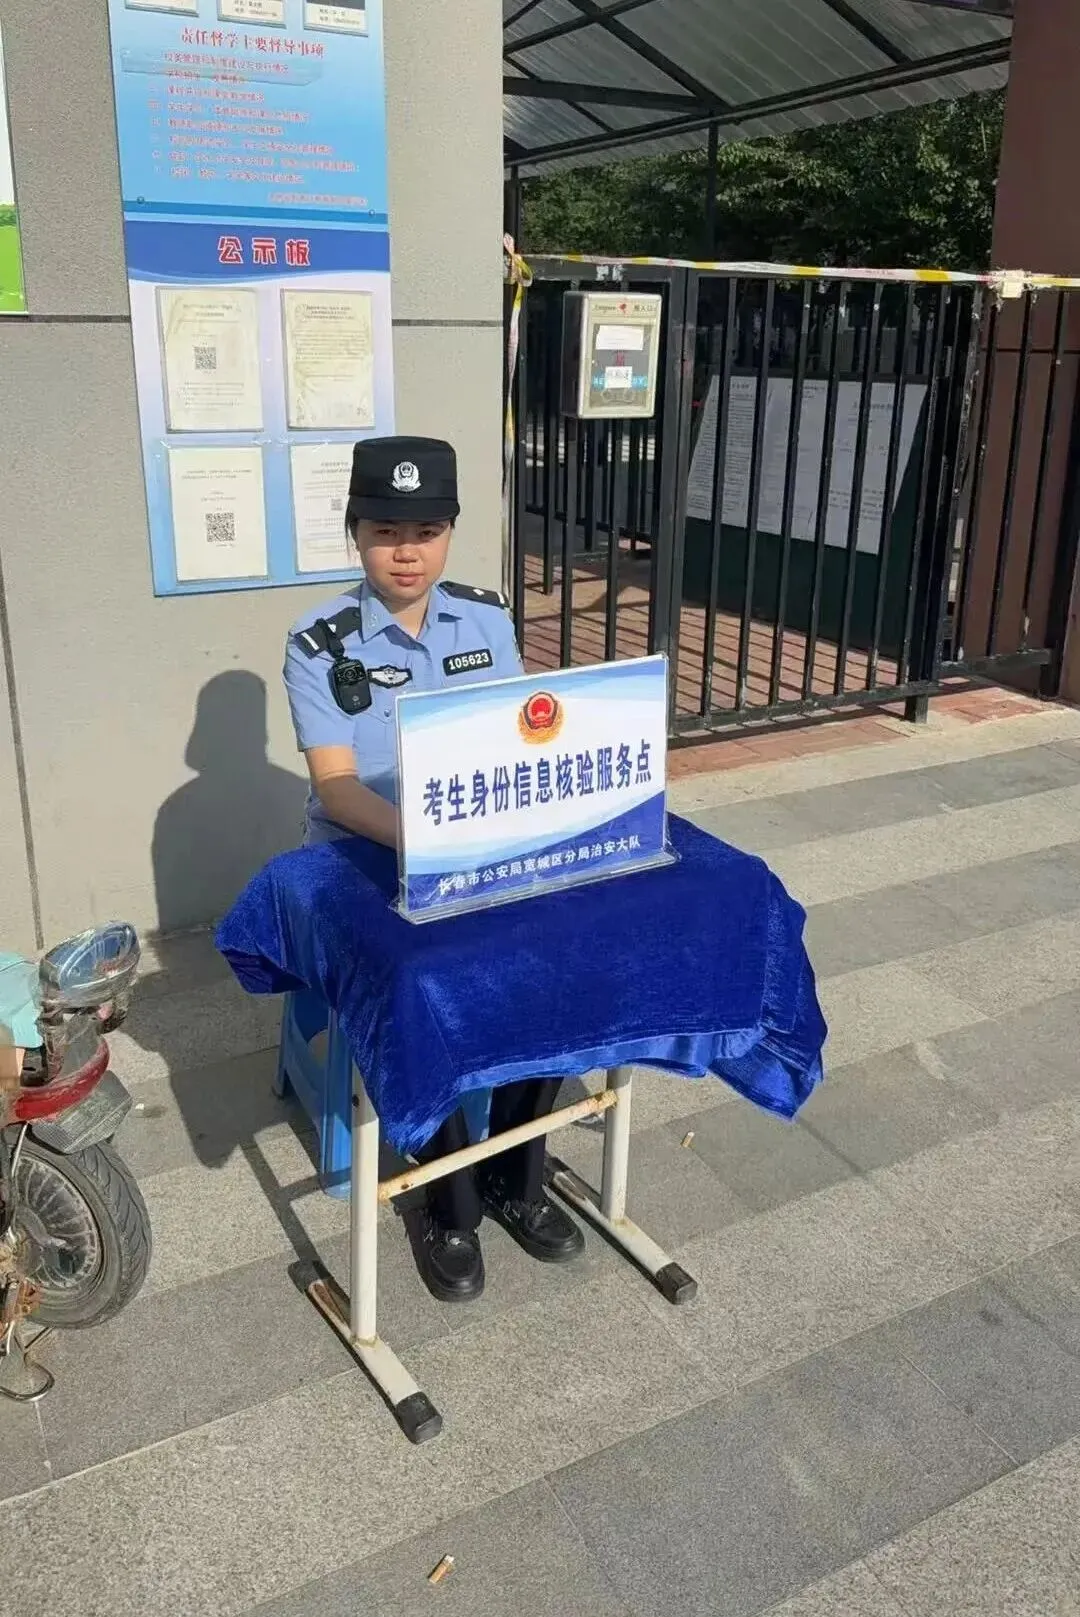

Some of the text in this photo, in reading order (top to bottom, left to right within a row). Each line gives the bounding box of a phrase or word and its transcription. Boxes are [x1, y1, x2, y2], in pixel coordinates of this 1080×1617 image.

[181, 27, 324, 58] 责任督学主要督导事项
[217, 236, 310, 266] 公示板
[448, 652, 489, 670] 105623
[423, 739, 652, 826] 考生身份信息核验服务点
[438, 835, 641, 896] 长春市公安局宽城区分局治安大队
